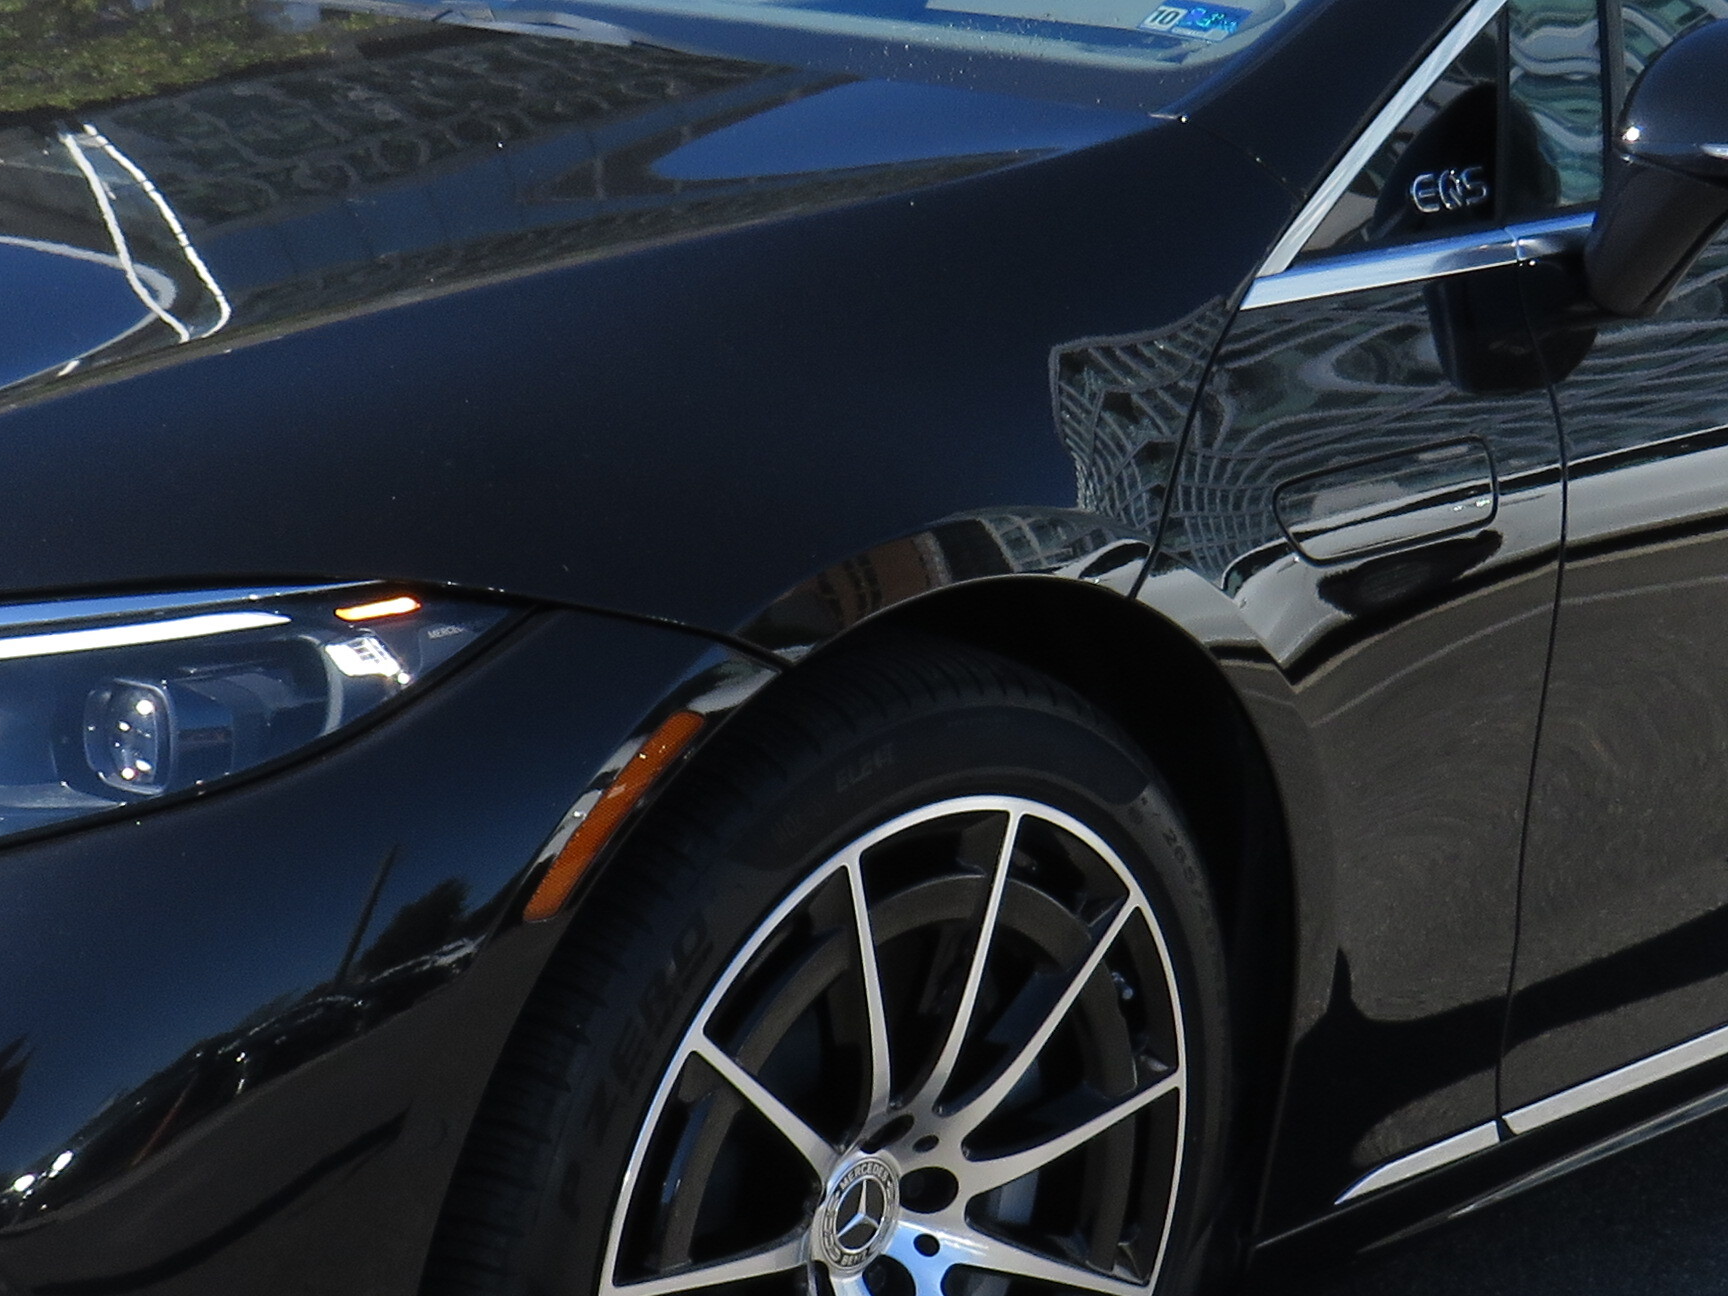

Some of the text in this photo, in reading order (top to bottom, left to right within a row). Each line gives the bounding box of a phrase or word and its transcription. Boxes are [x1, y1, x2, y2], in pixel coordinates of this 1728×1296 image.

[1149, 8, 1181, 26] 10
[1412, 166, 1488, 213] EQS
[839, 1162, 890, 1191] MERCEDES
